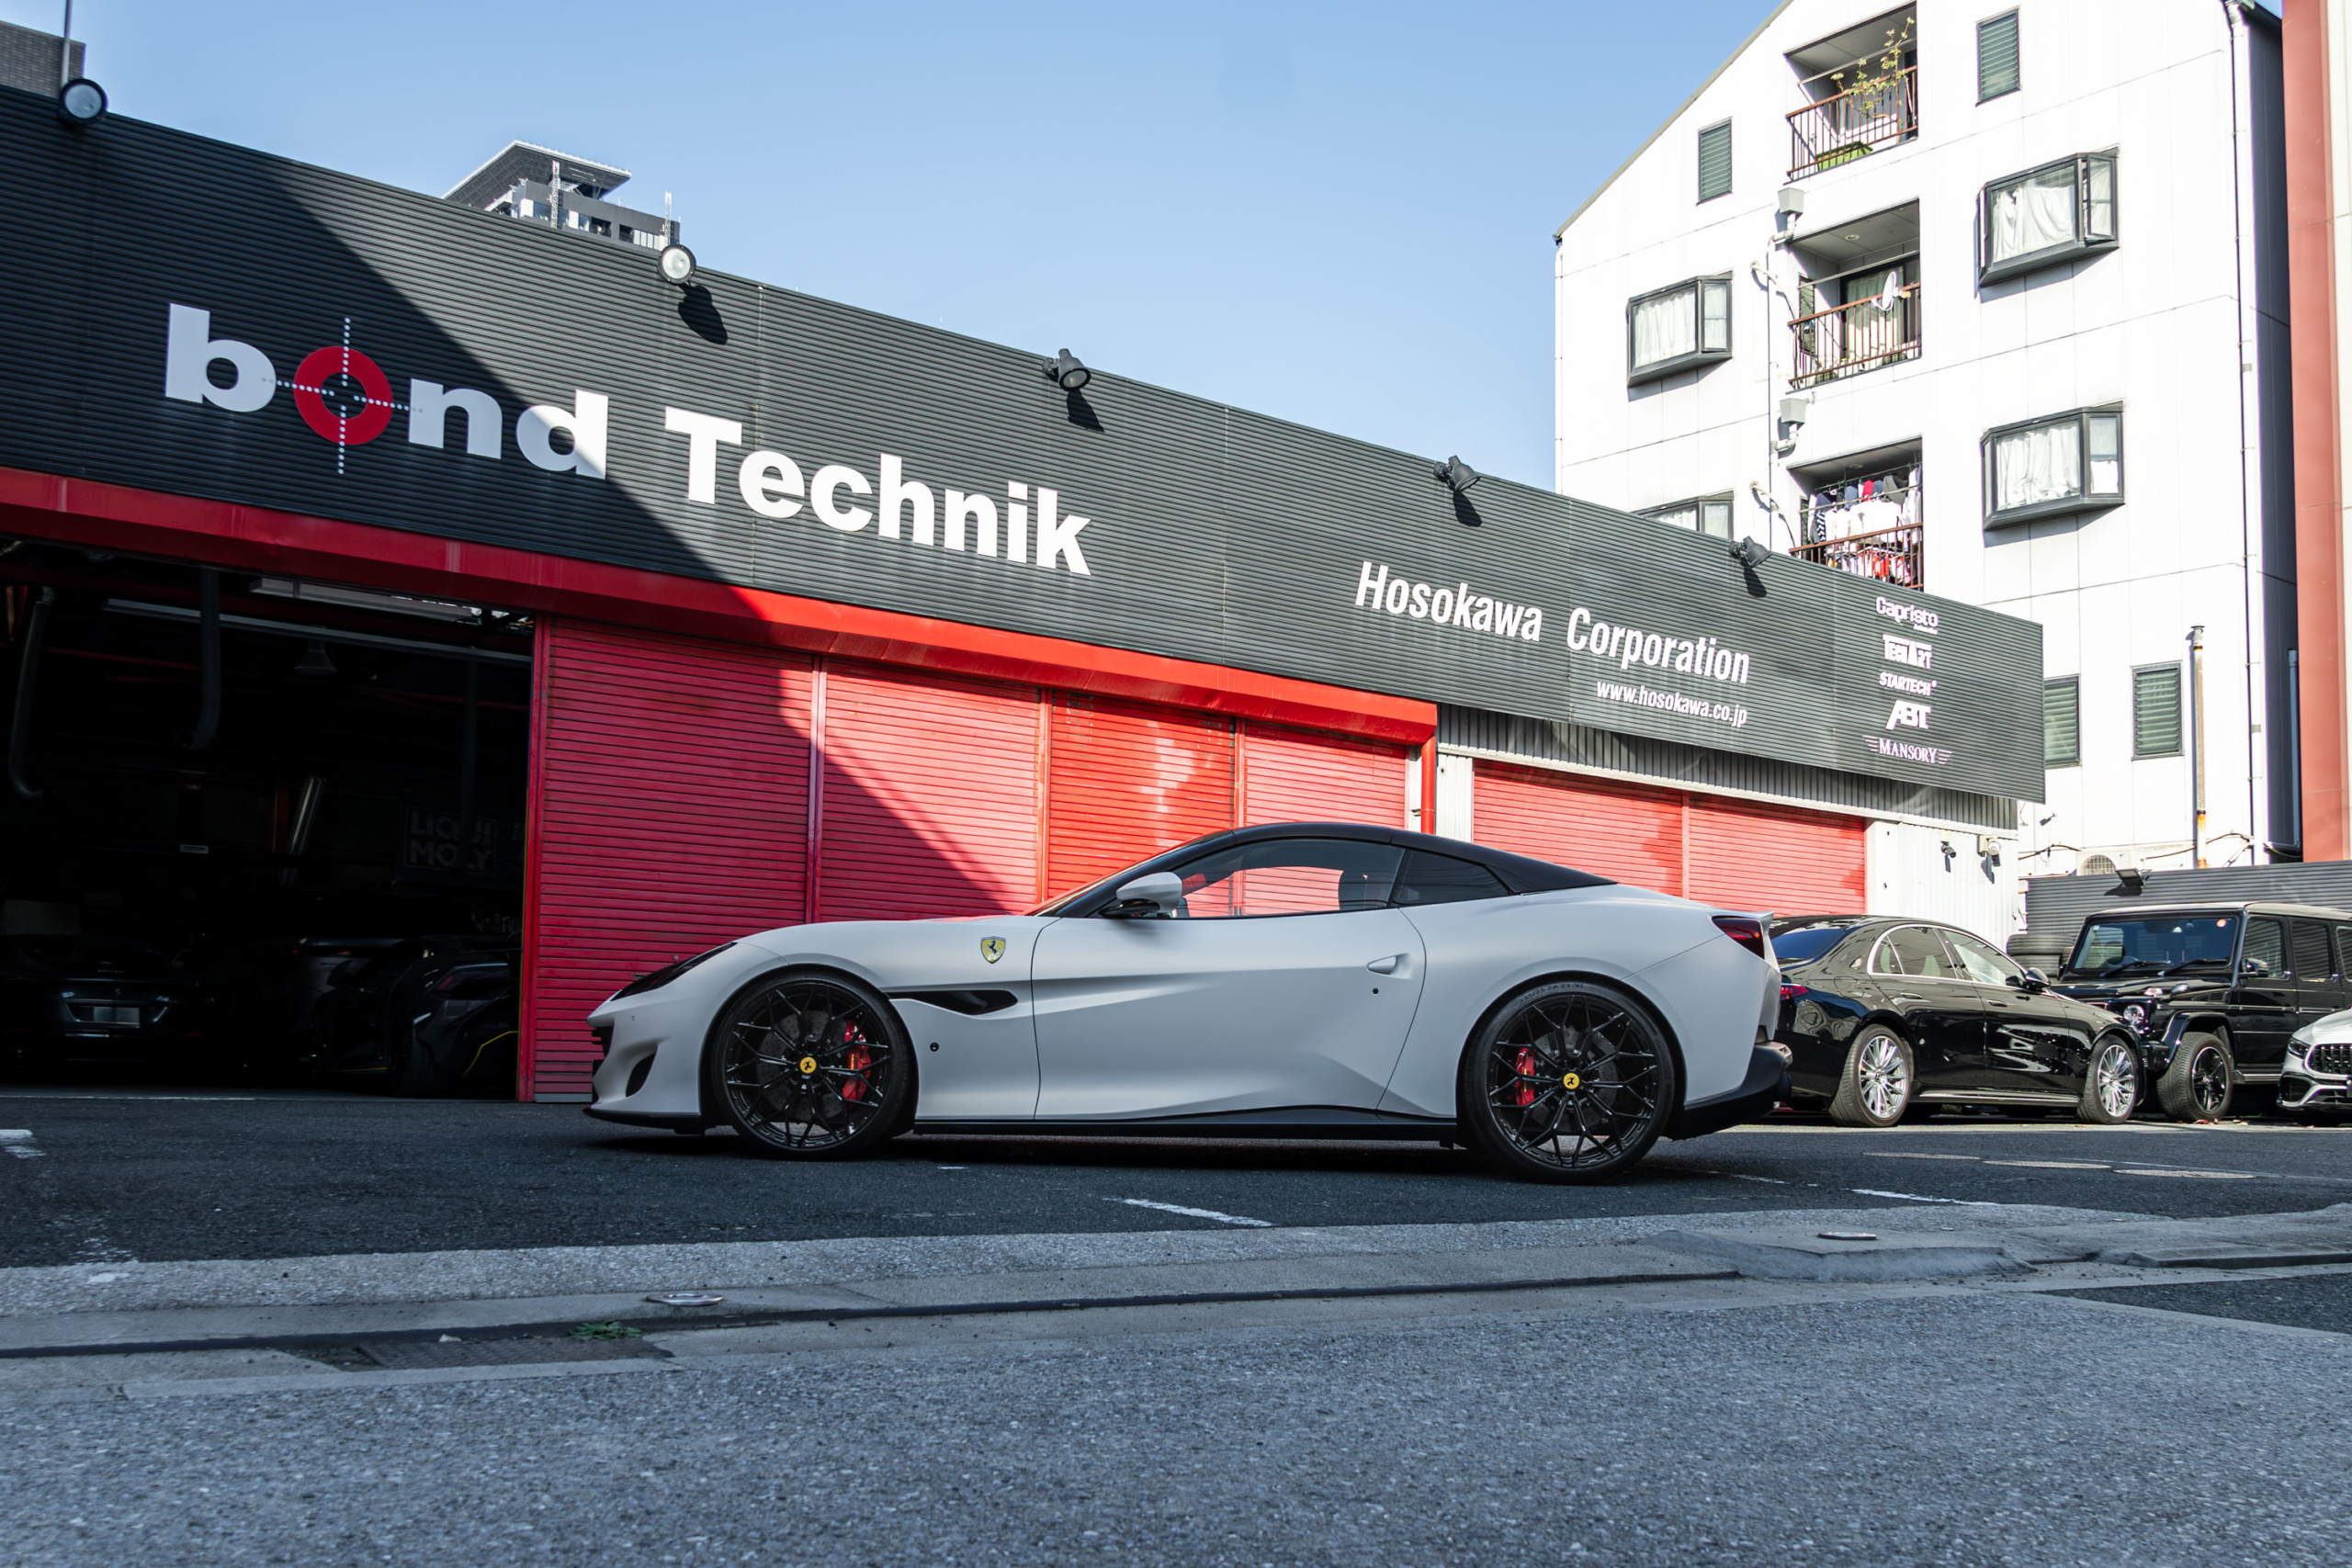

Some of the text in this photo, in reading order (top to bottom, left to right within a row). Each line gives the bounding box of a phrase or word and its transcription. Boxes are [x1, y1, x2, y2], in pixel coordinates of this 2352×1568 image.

[165, 303, 1091, 576] bond Technik
[1355, 561, 1750, 685] Hosokawa Corporation
[1876, 596, 1939, 627] Capristo
[1596, 680, 1748, 728] www.hosokawa.co.jp
[1885, 700, 1932, 730] ABT
[1878, 738, 1939, 764] MANSORY
